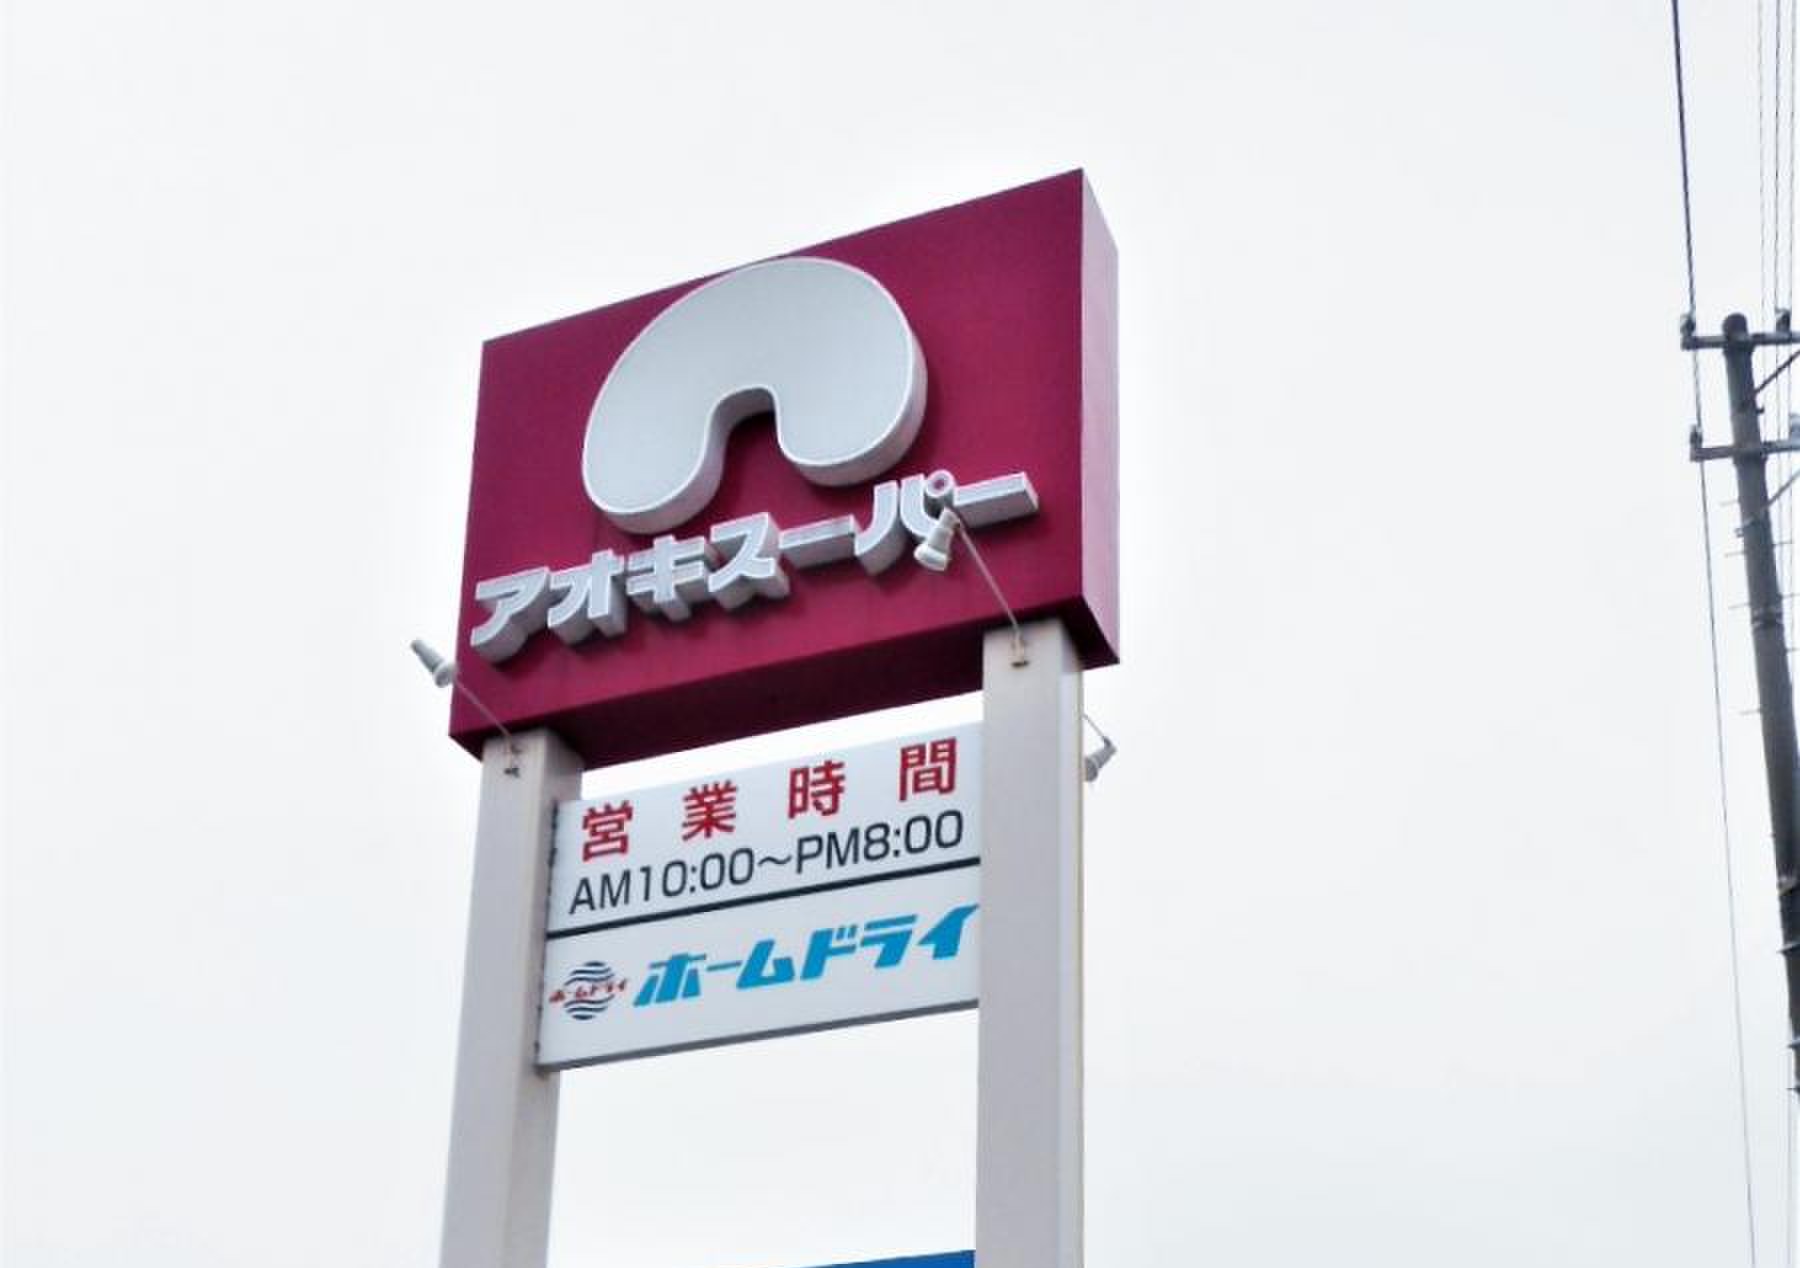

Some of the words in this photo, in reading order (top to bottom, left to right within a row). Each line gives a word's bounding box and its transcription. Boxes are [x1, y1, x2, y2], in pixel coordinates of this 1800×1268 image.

[470, 471, 1040, 655] アオキスーパー
[582, 738, 958, 862] 営業時間
[634, 904, 979, 1007] ホームドライ
